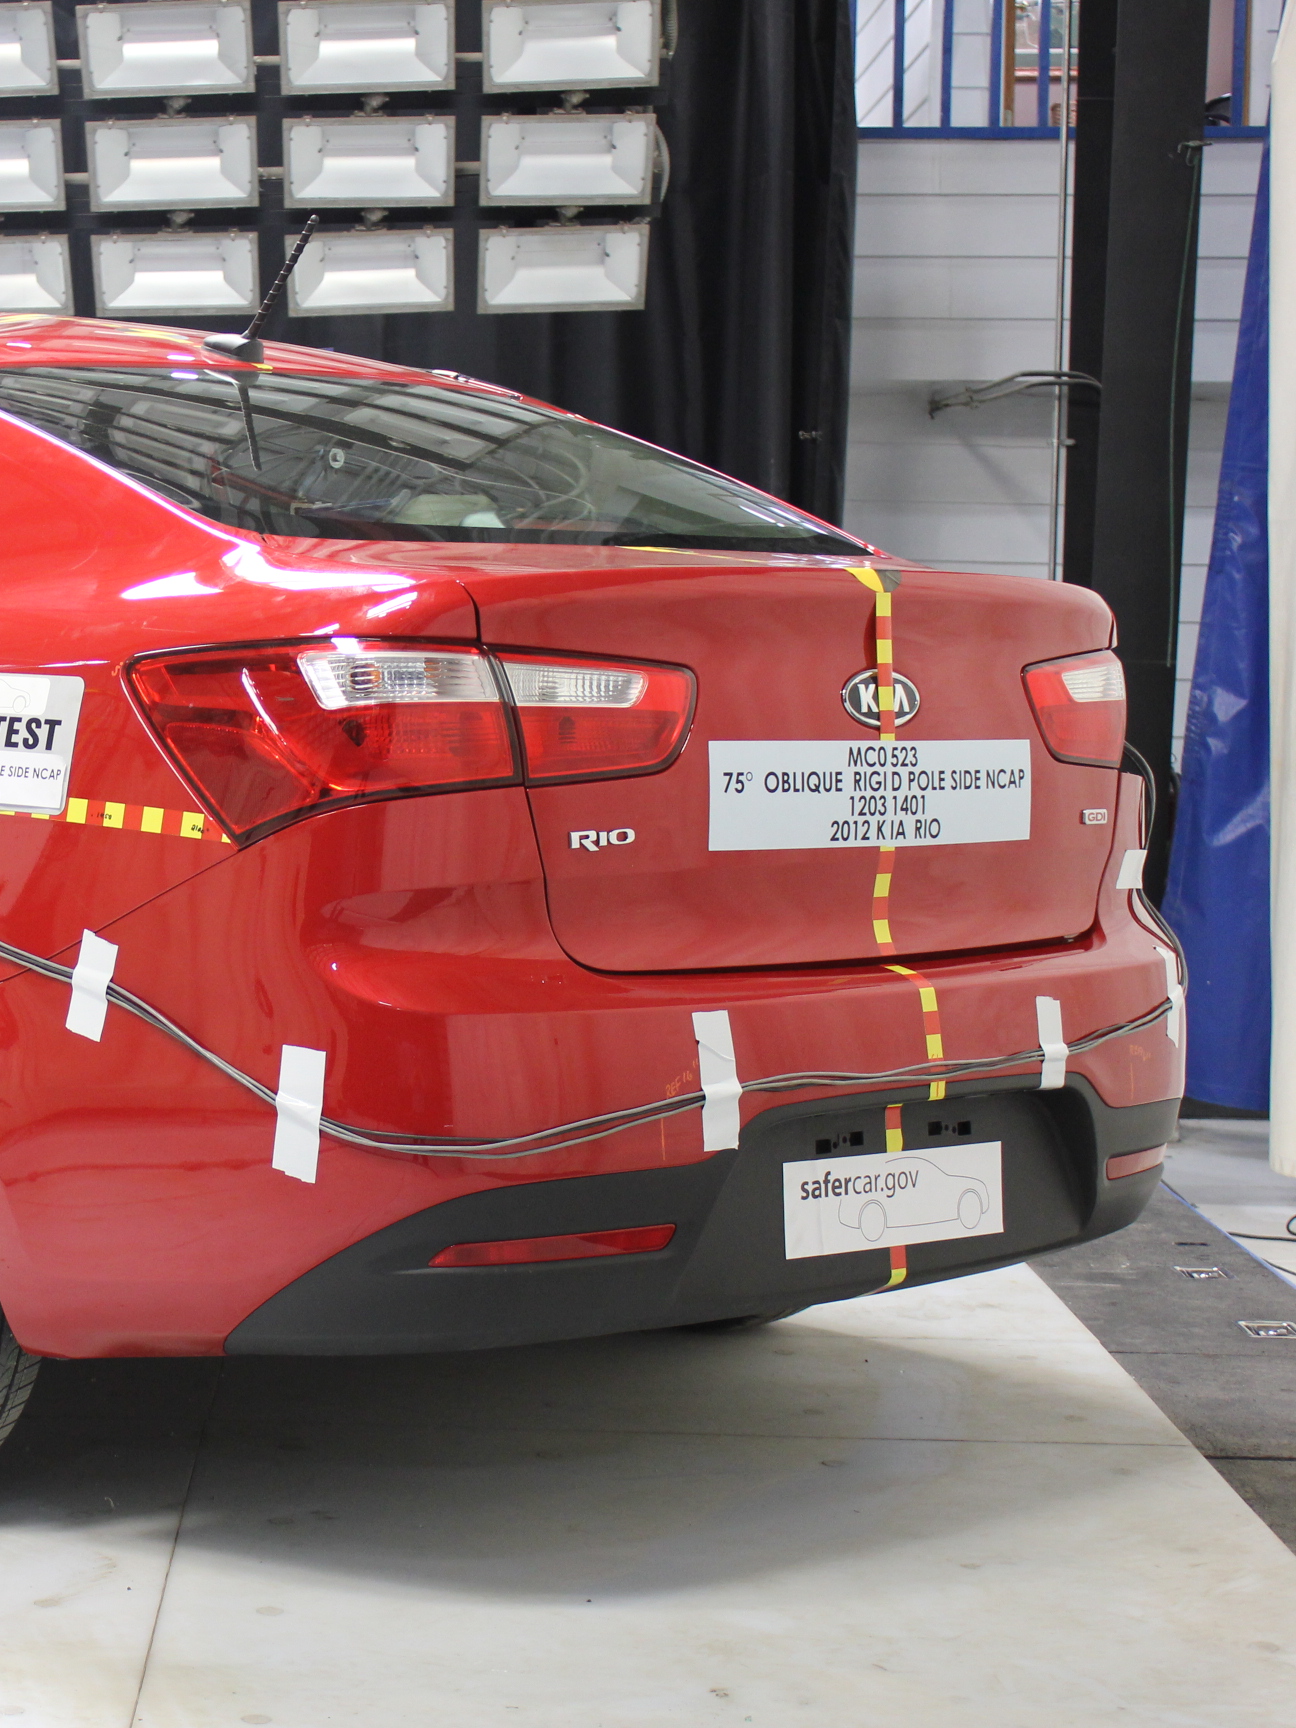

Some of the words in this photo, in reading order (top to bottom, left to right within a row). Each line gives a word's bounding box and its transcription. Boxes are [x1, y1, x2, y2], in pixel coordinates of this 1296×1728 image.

[857, 683, 910, 713] KA
[8, 766, 29, 779] SIDE
[32, 768, 62, 781] NCAP
[723, 771, 754, 794] 75°
[764, 771, 843, 794] OBLIQUE
[853, 770, 902, 792] RIGID
[908, 770, 946, 791] POLE
[950, 769, 981, 791] SIDE
[986, 768, 1025, 790] NCAP
[830, 819, 870, 841] 2012
[914, 818, 941, 839] RIO
[1087, 812, 1106, 822] GDI
[569, 827, 636, 852] RIO
[800, 1168, 920, 1200] safercar.gov
